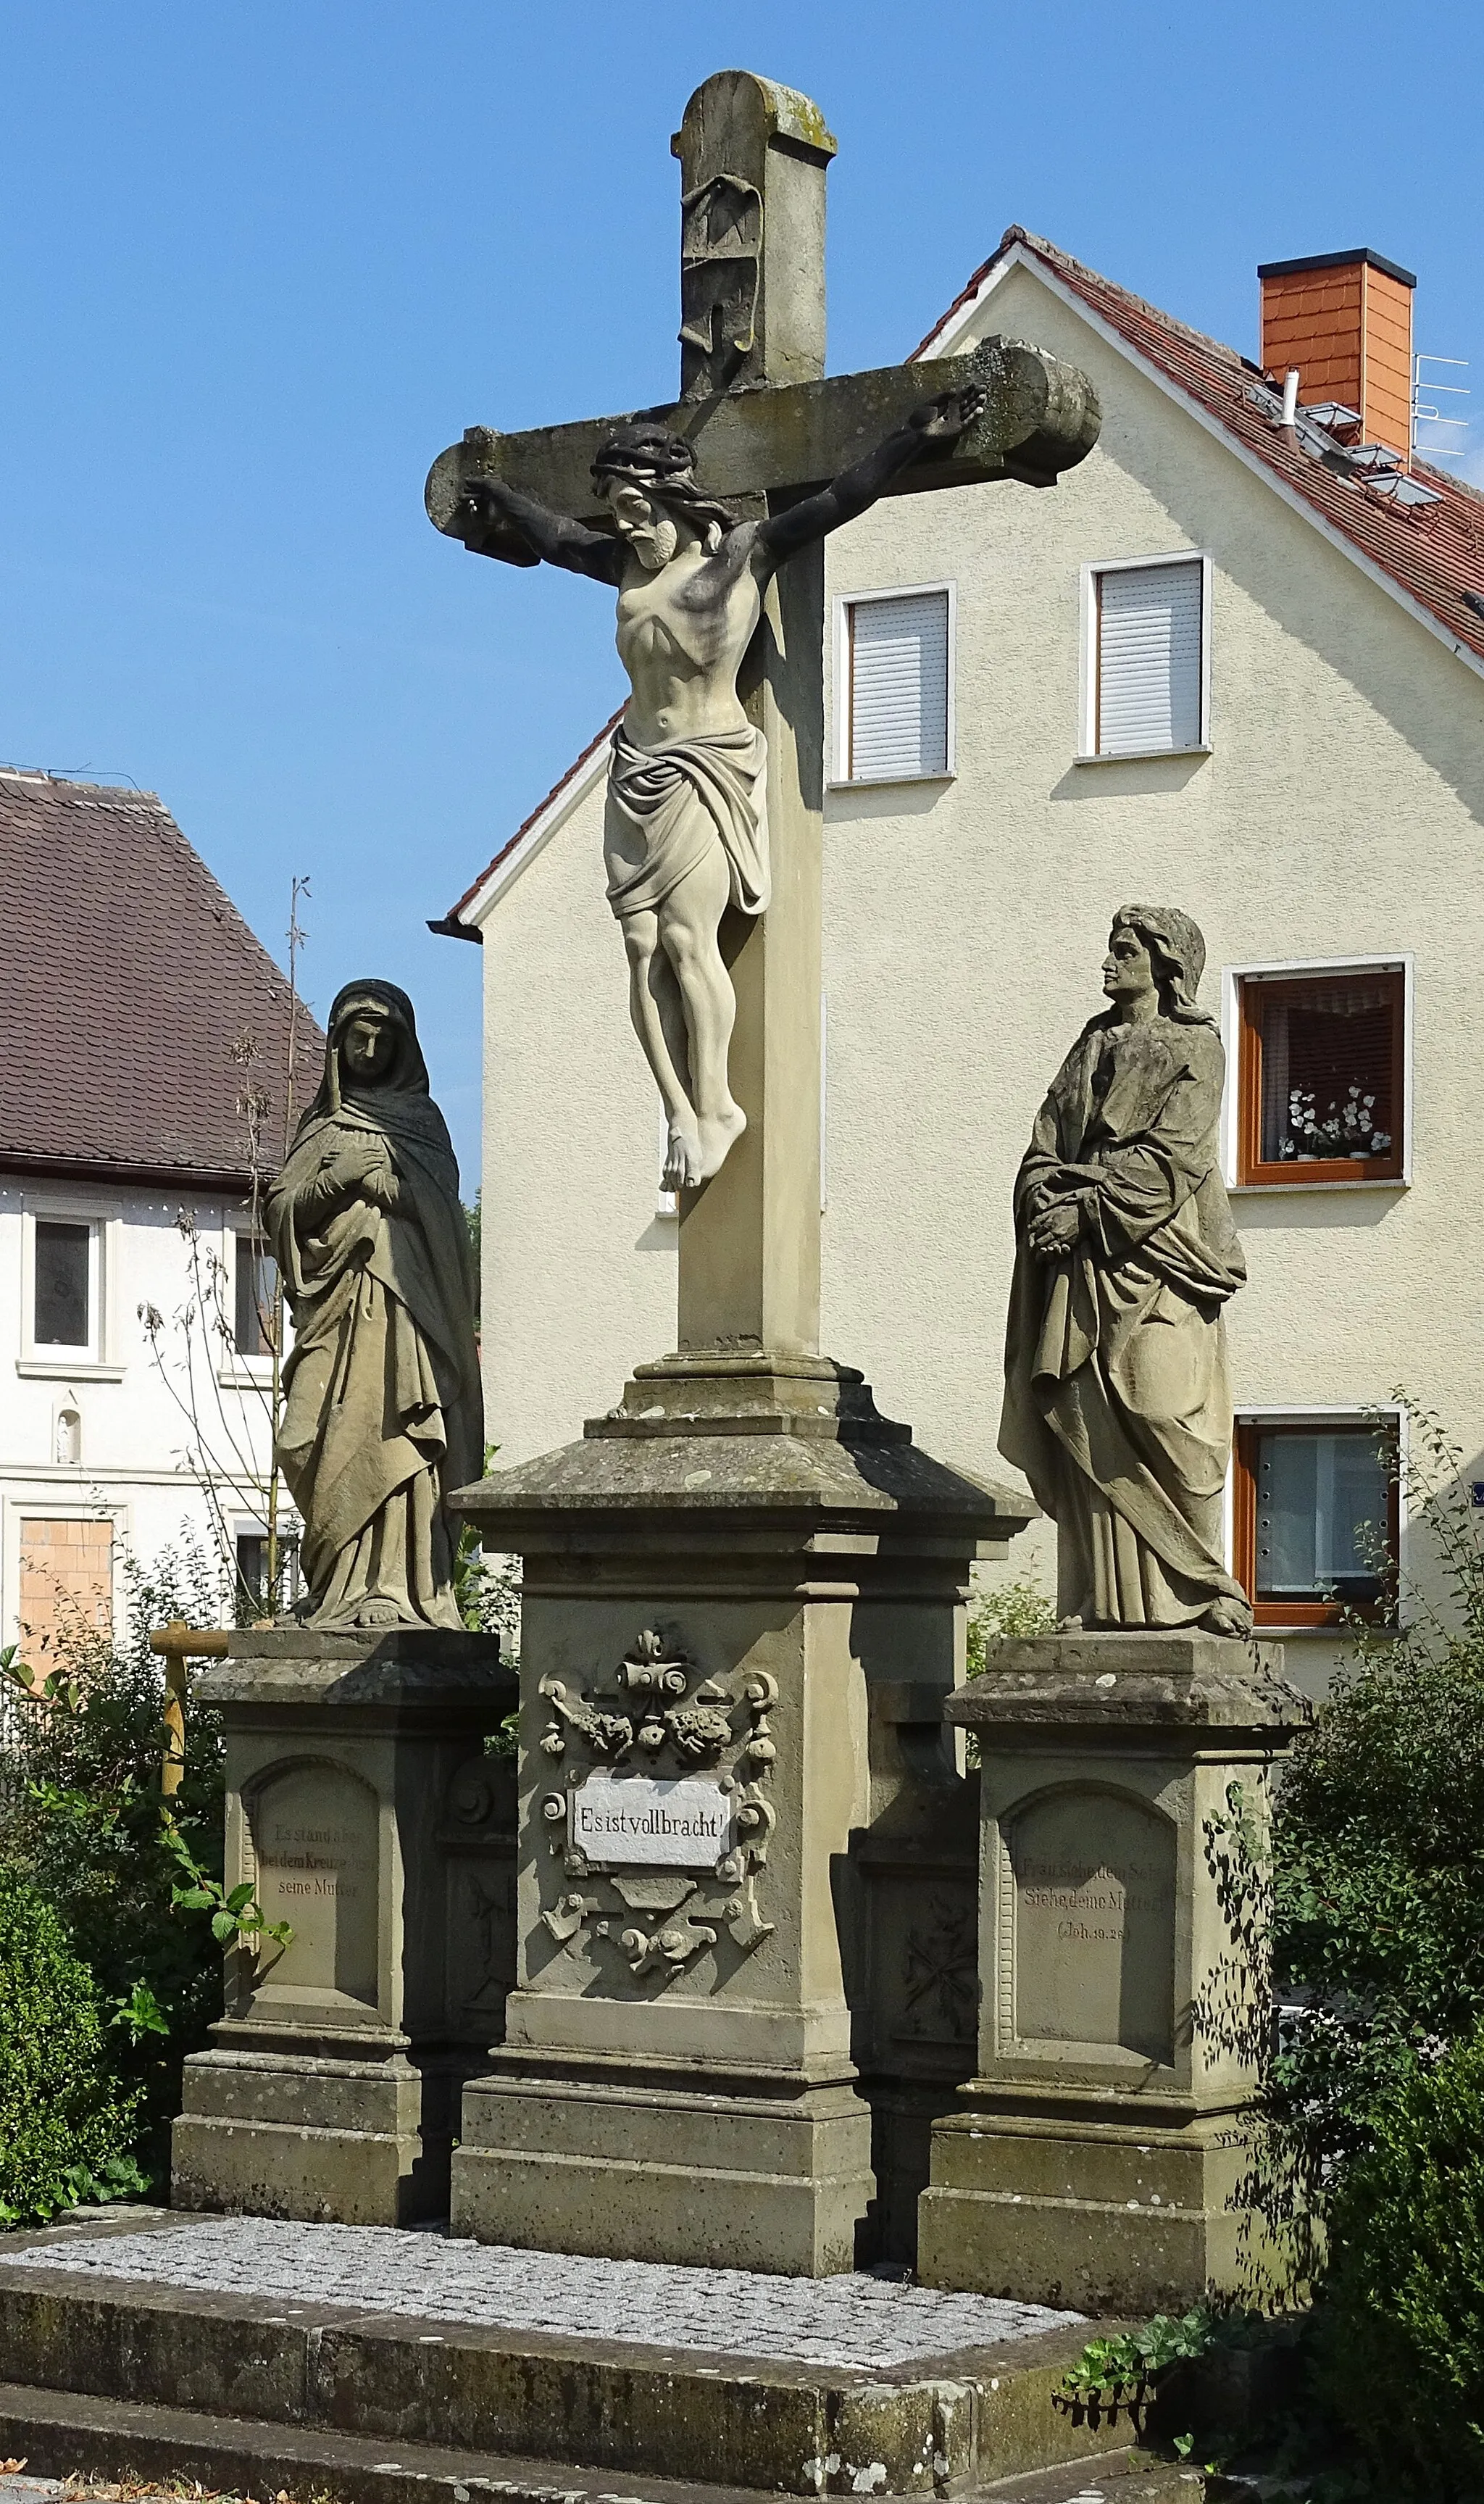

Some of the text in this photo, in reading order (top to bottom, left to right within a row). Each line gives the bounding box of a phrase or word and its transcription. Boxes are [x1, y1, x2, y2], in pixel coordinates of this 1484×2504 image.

[580, 1807, 724, 1839] Es ist vollbracht!
[280, 1850, 304, 1868] dem
[278, 1878, 311, 1894] seine
[1069, 1889, 1106, 1910] deine
